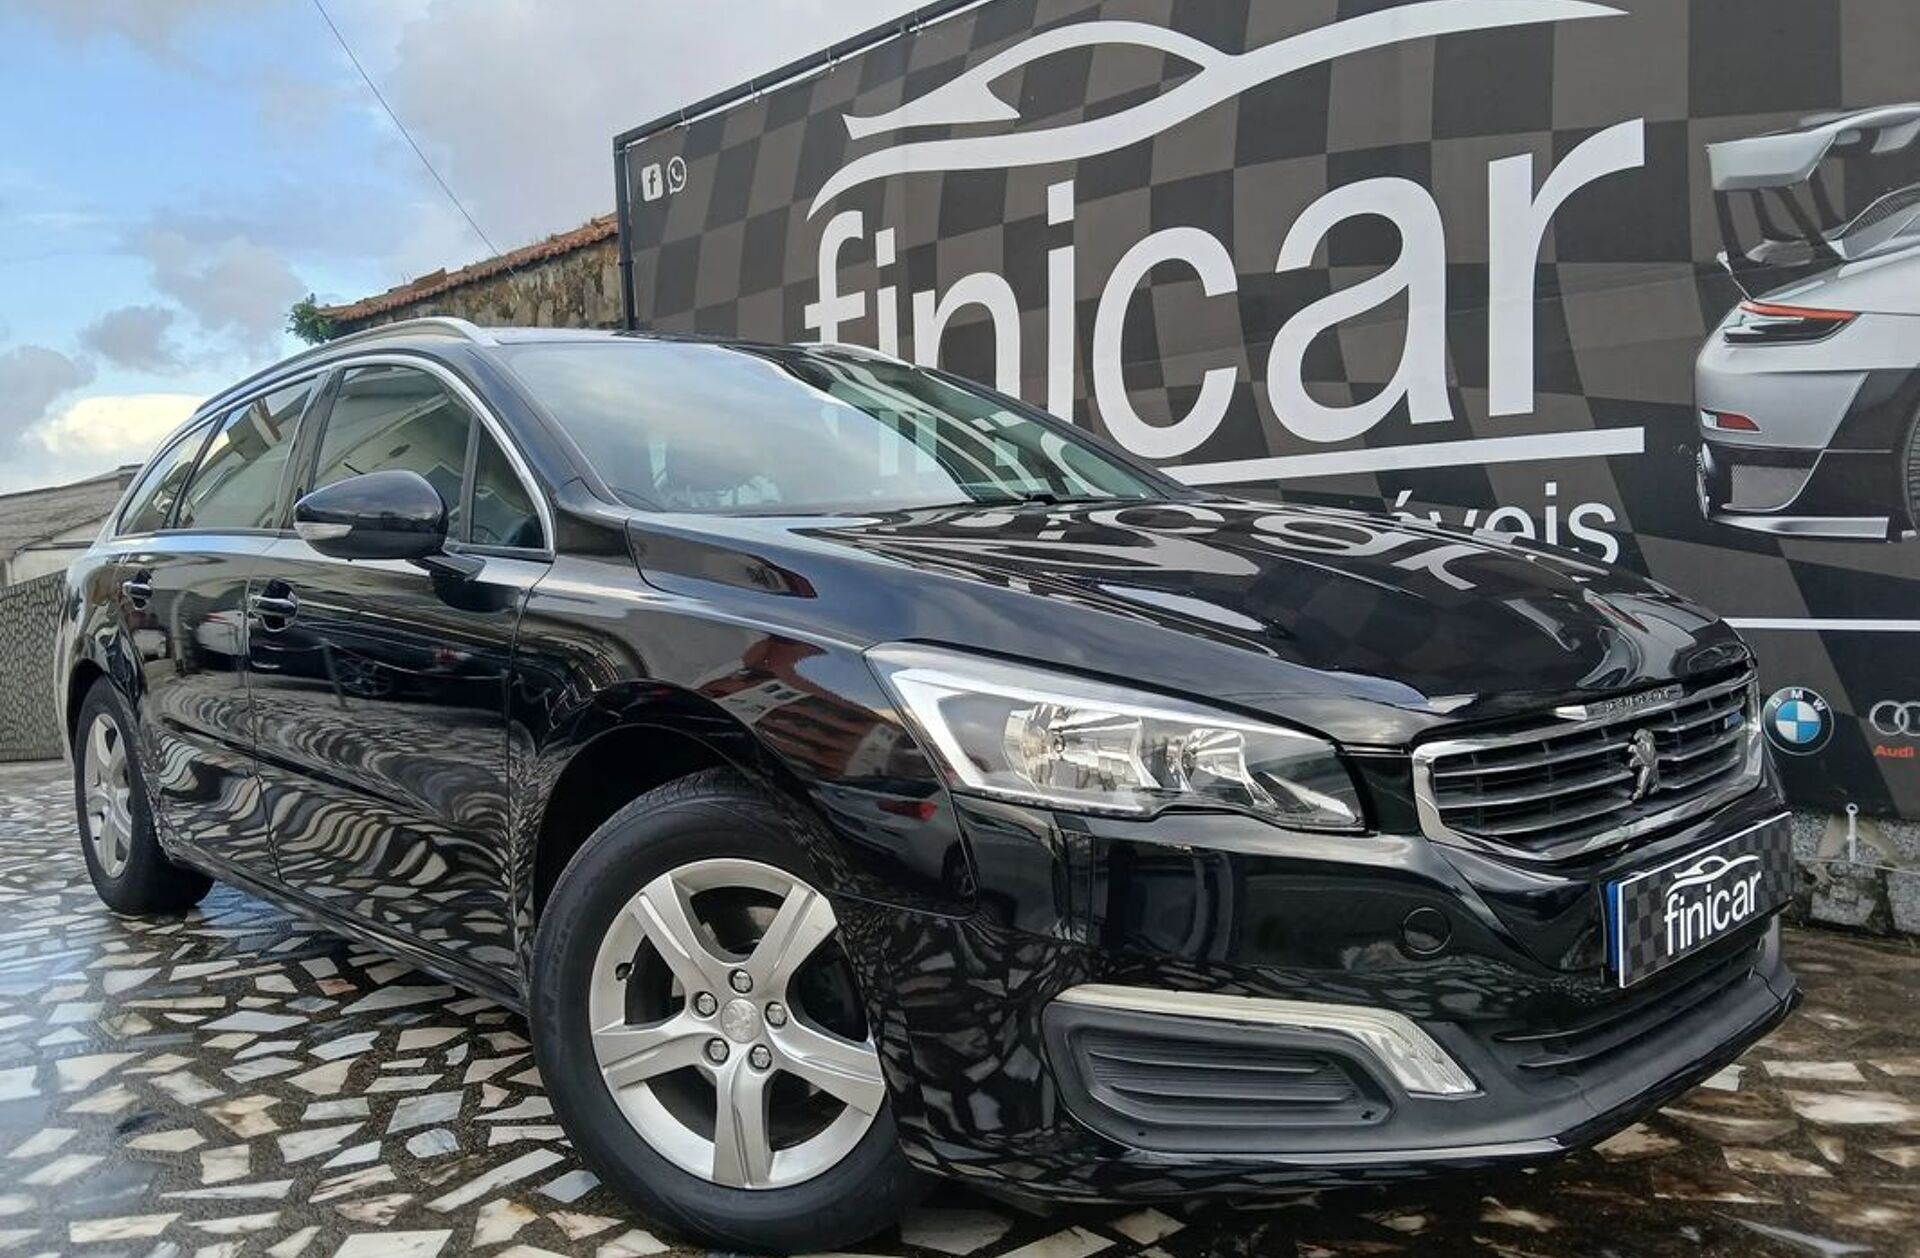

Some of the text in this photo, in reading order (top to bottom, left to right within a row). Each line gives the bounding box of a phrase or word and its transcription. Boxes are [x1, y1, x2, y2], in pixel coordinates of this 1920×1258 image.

[804, 117, 1645, 460] finicar
[1769, 689, 1826, 712] BMW
[1873, 744, 1914, 758] Audi
[1664, 871, 1762, 956] finicar
